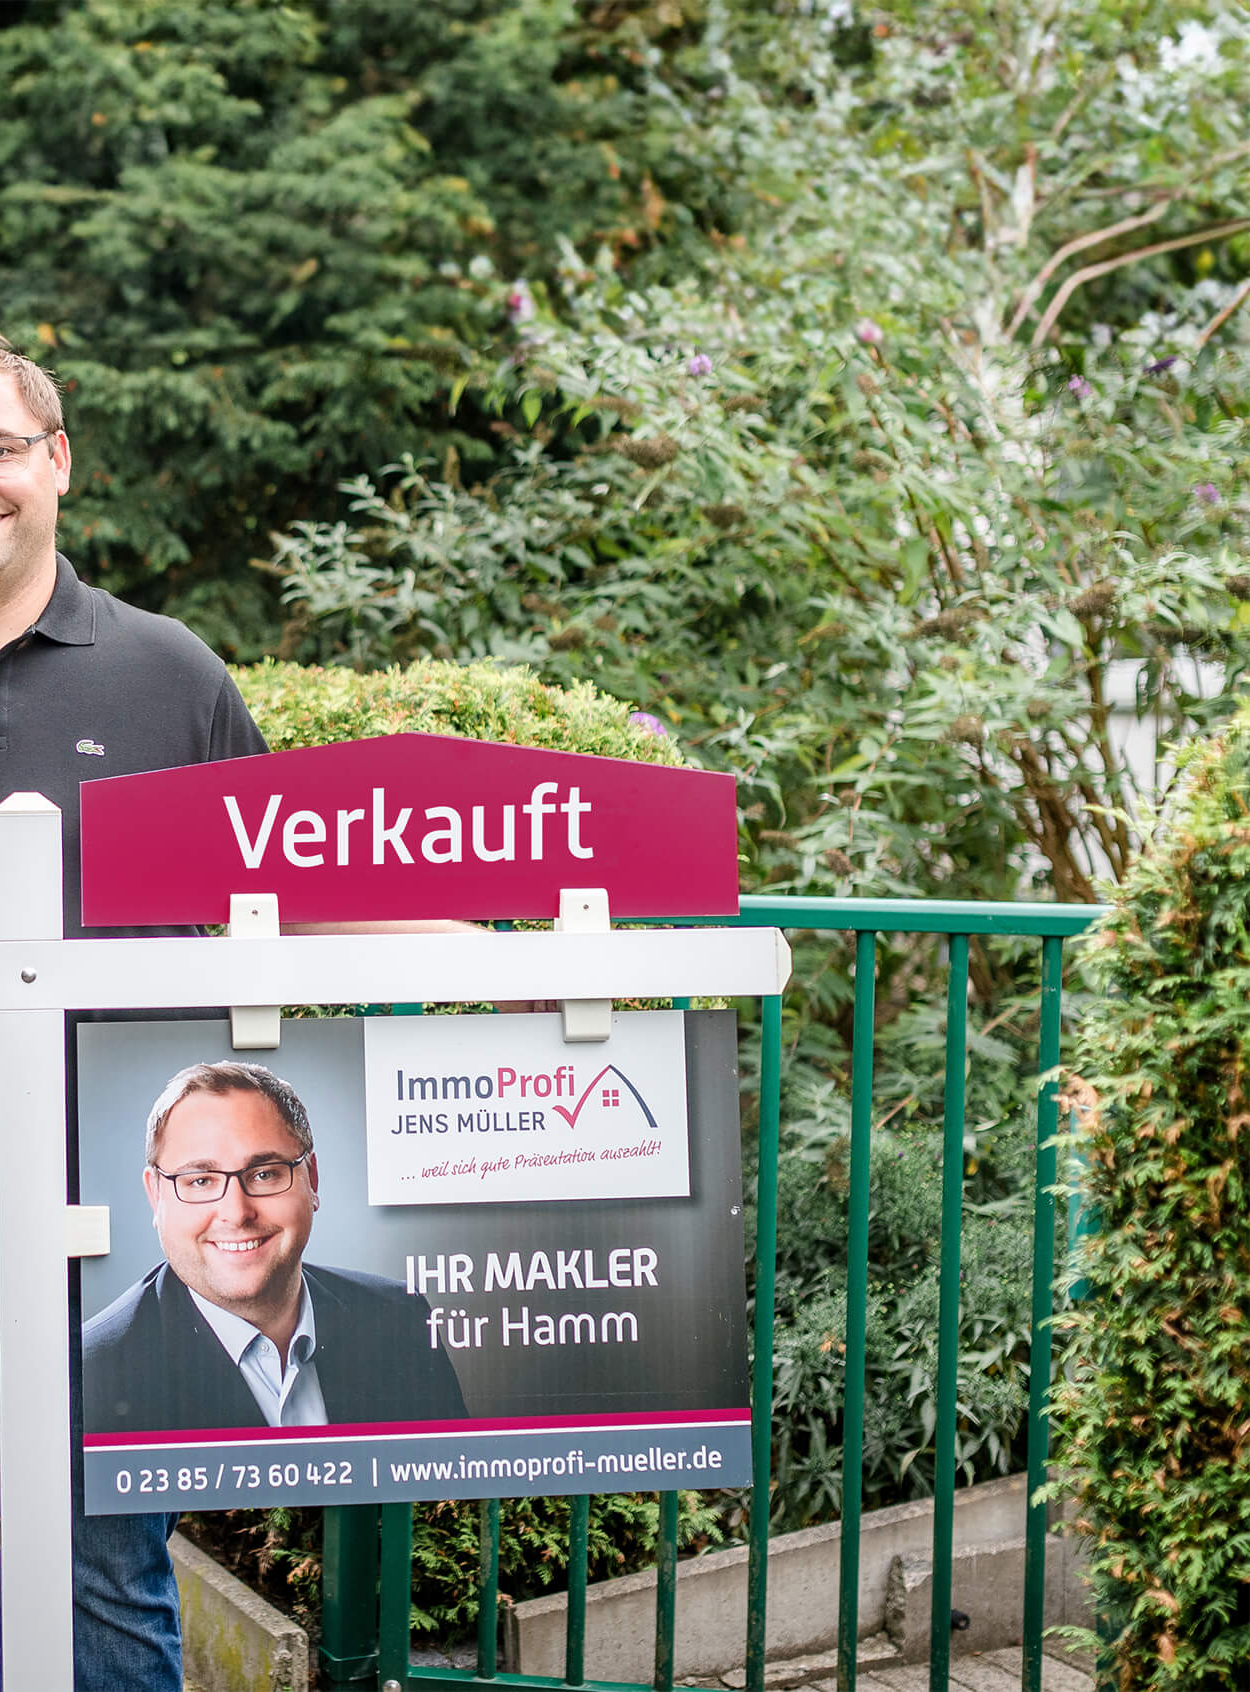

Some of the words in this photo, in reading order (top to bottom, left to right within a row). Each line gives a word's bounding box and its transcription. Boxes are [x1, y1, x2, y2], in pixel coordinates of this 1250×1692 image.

[223, 782, 595, 869] Verkauft
[397, 1066, 575, 1101] ImmoProfi
[391, 1114, 449, 1135] JENS
[457, 1109, 546, 1132] MÜLLER
[421, 1161, 449, 1179] weil
[450, 1156, 477, 1176] sich
[480, 1154, 511, 1180] gute
[514, 1149, 596, 1169] Präsentation
[600, 1141, 662, 1161] auszahlt!
[406, 1254, 474, 1294] IHR
[484, 1248, 659, 1292] MAKLER
[426, 1307, 489, 1349] für
[502, 1306, 638, 1346] Hamm
[116, 1471, 131, 1493] 0
[139, 1469, 168, 1492] 23
[177, 1467, 208, 1490] 85
[232, 1465, 262, 1488] 73
[268, 1463, 299, 1487] 60
[306, 1461, 353, 1485] 422
[391, 1446, 723, 1483] www.immoprofi-mueller.de
